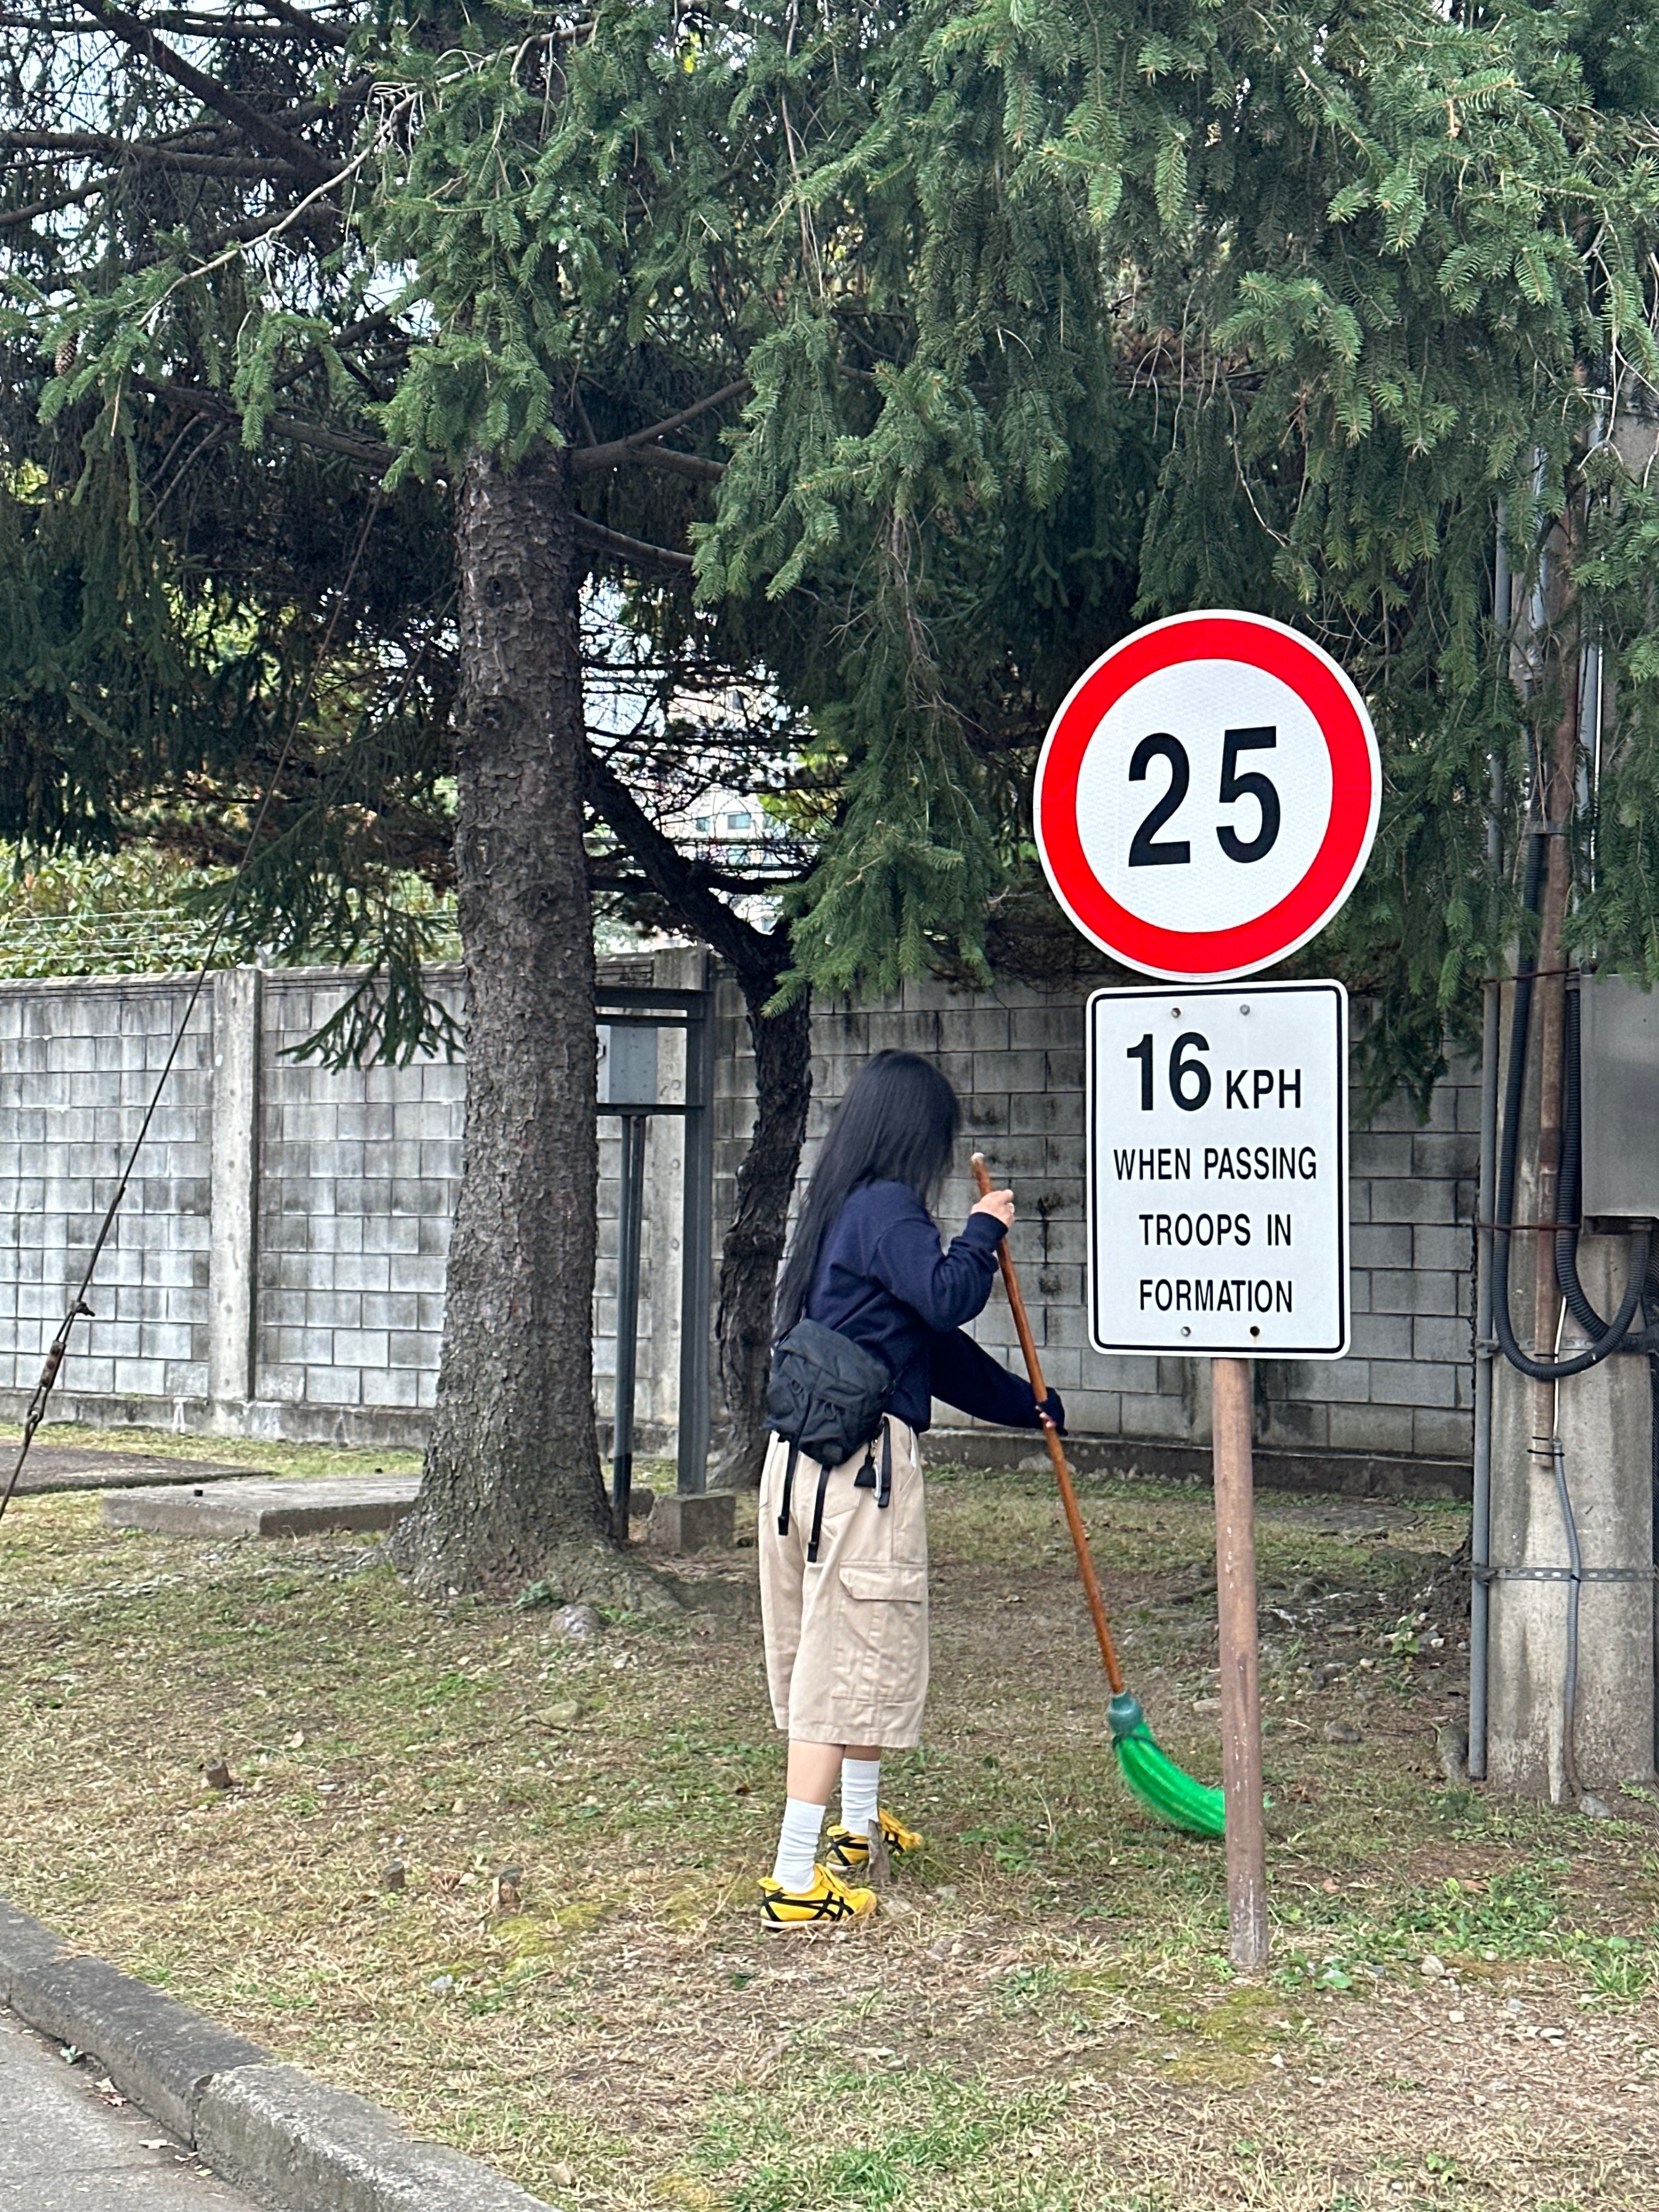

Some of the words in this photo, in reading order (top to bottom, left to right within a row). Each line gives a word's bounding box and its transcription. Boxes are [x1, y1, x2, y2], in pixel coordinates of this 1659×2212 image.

[1128, 725, 1281, 867] 25
[1126, 1031, 1211, 1111] 16
[1226, 1069, 1301, 1109] KPH
[1113, 1148, 1190, 1181] WHEN
[1204, 1146, 1316, 1180] PASSING
[1139, 1213, 1251, 1246] TROOPS
[1267, 1214, 1291, 1246] IN
[1140, 1279, 1292, 1313] FORMATION
